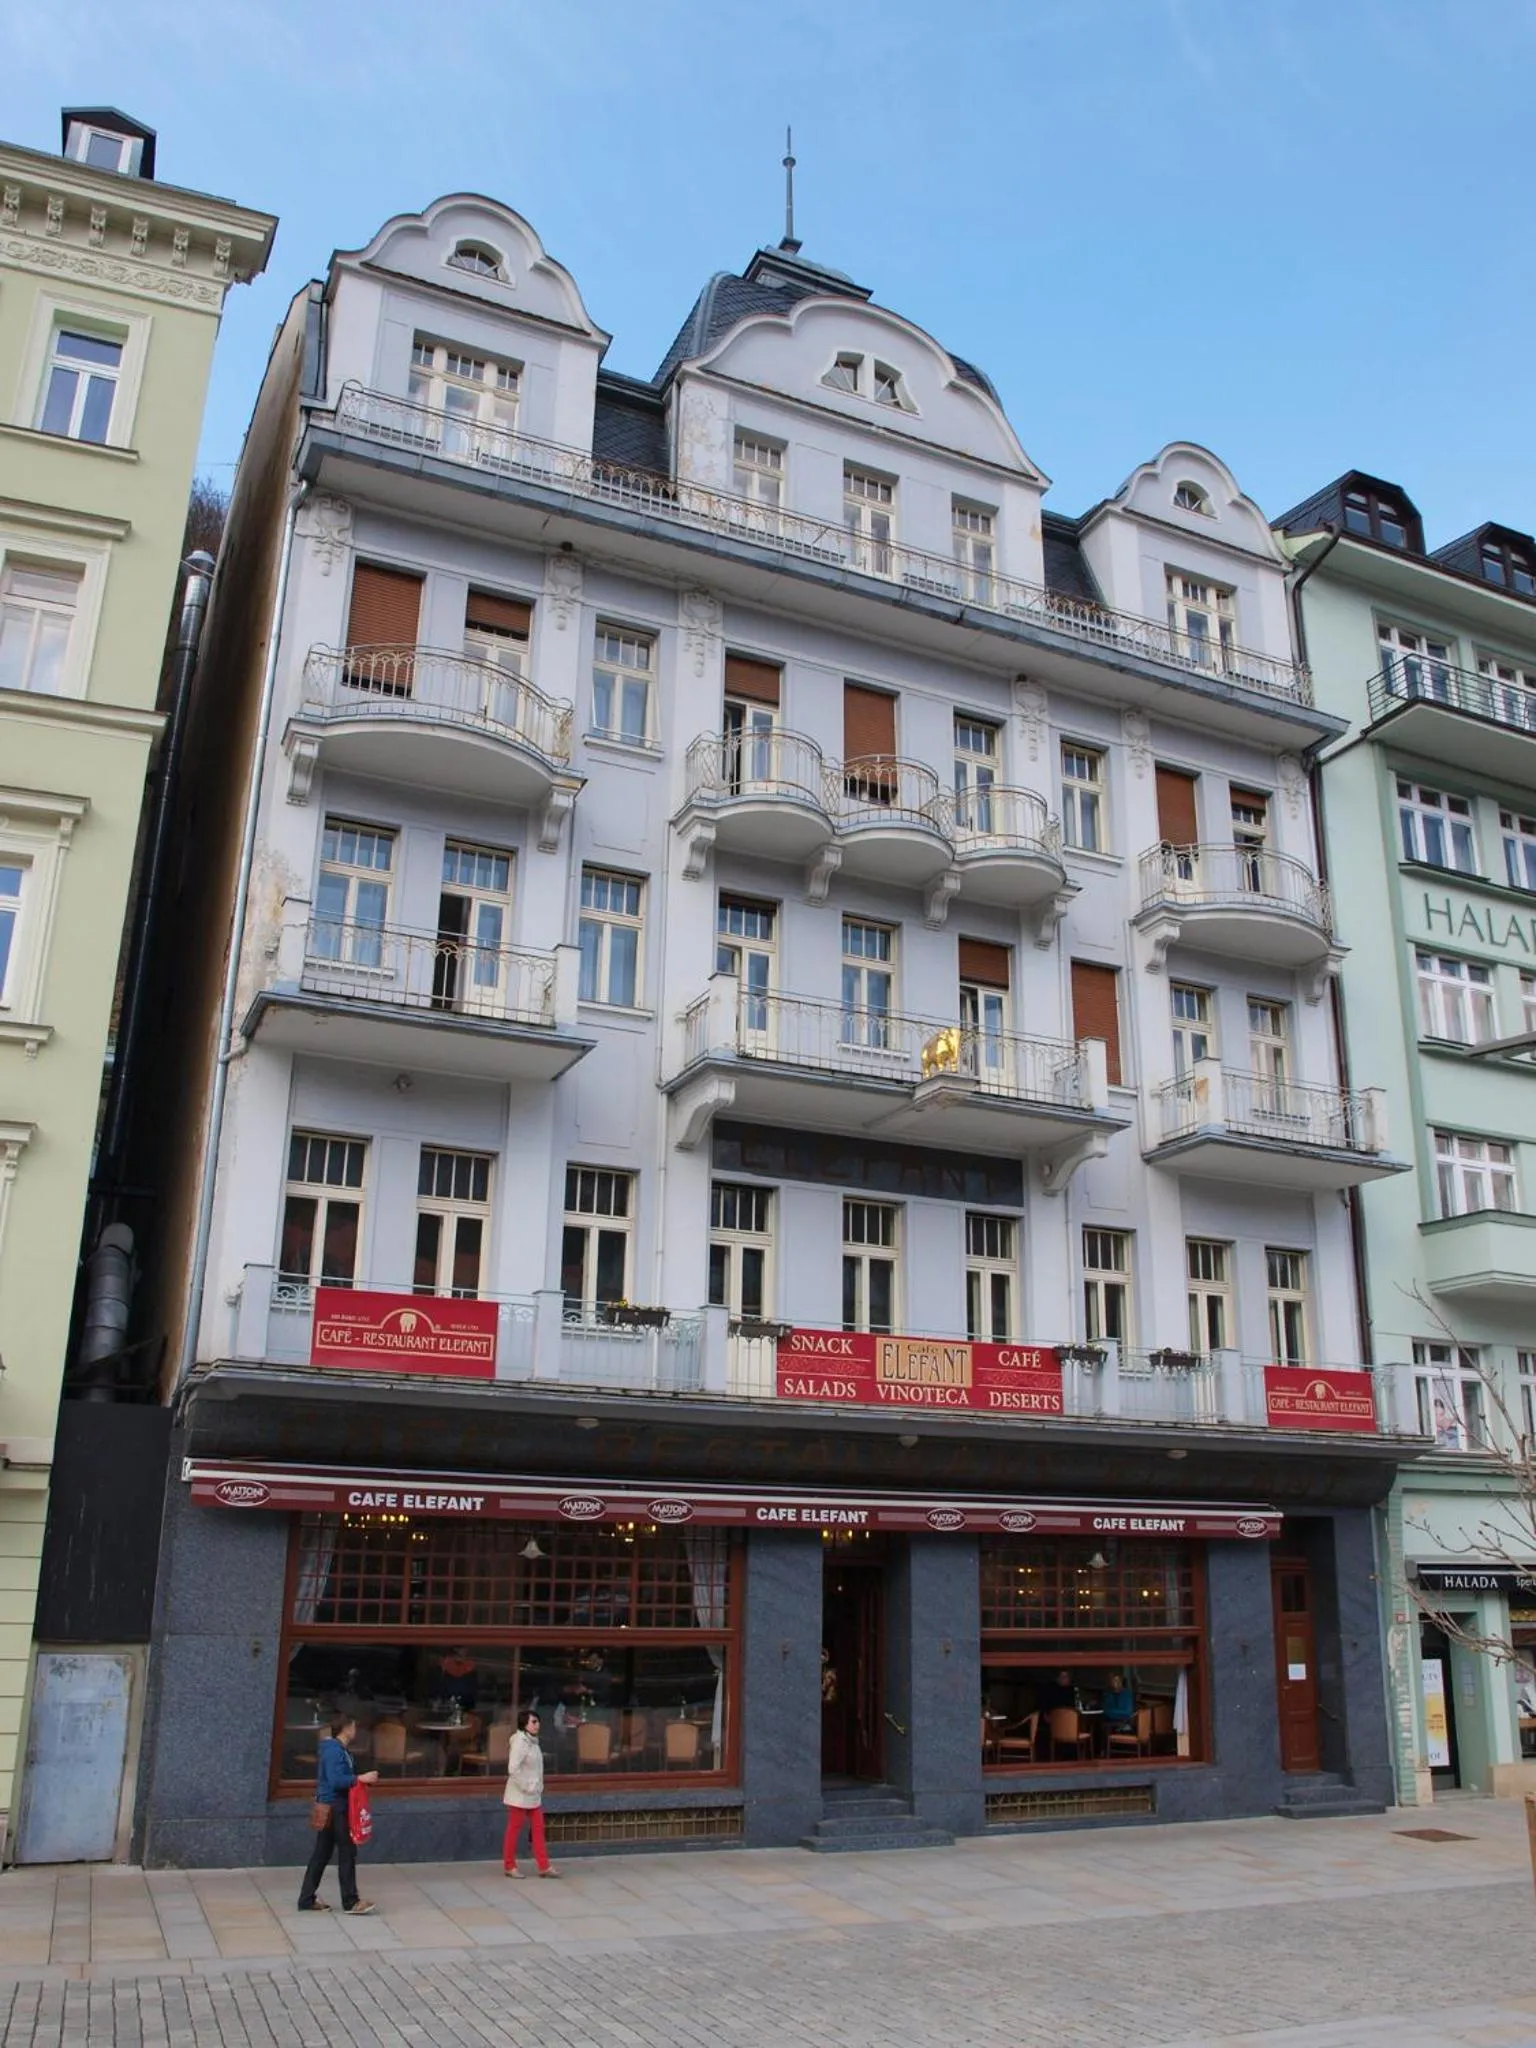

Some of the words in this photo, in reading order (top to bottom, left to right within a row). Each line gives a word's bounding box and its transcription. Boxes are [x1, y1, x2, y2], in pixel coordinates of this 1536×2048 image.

[321, 1328, 352, 1344] CAFÉ
[363, 1332, 436, 1350] RESTAURANT
[439, 1339, 488, 1354] ELEFANT
[791, 1334, 853, 1355] SNACK
[883, 1343, 967, 1384] ELEFANT
[998, 1350, 1042, 1368] CAFÉ
[784, 1378, 857, 1398] SALADS
[876, 1384, 969, 1406] VINOTECA
[989, 1391, 1060, 1411] DESERTS
[348, 1491, 398, 1508] CAFE
[403, 1493, 484, 1511] ELEFANT
[756, 1506, 797, 1522] CAFE
[801, 1508, 869, 1524] ELEFANT
[1093, 1516, 1127, 1530] CAFE
[1130, 1518, 1186, 1532] ELEFANT
[1444, 1575, 1499, 1589] HALADA
